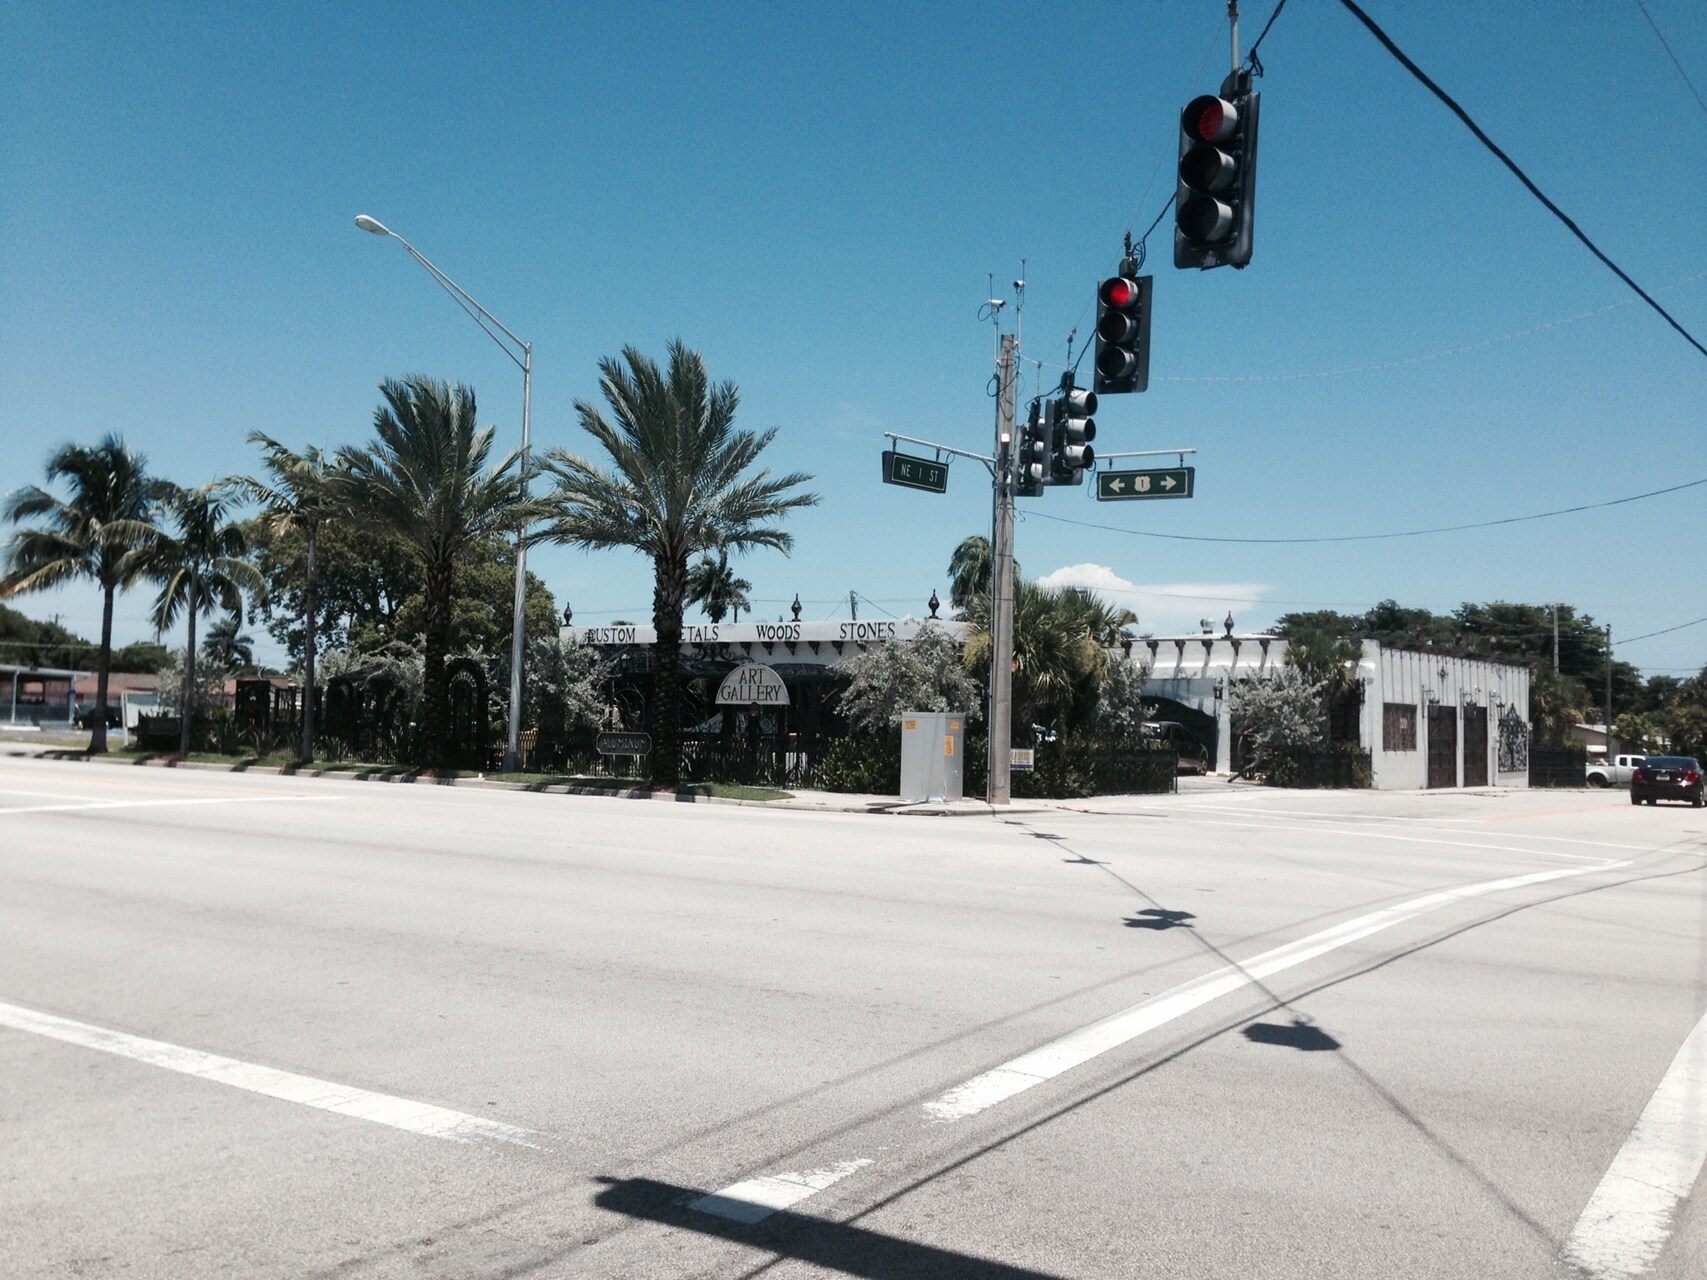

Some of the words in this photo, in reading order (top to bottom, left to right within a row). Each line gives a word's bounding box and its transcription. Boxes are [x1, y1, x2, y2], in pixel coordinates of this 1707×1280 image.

[900, 463, 911, 477] NE
[928, 469, 939, 482] ST
[680, 626, 719, 641] ETALS
[756, 624, 801, 640] WOODS
[840, 622, 896, 639] STONES
[739, 668, 766, 684] ART
[721, 685, 781, 701] GALLERY
